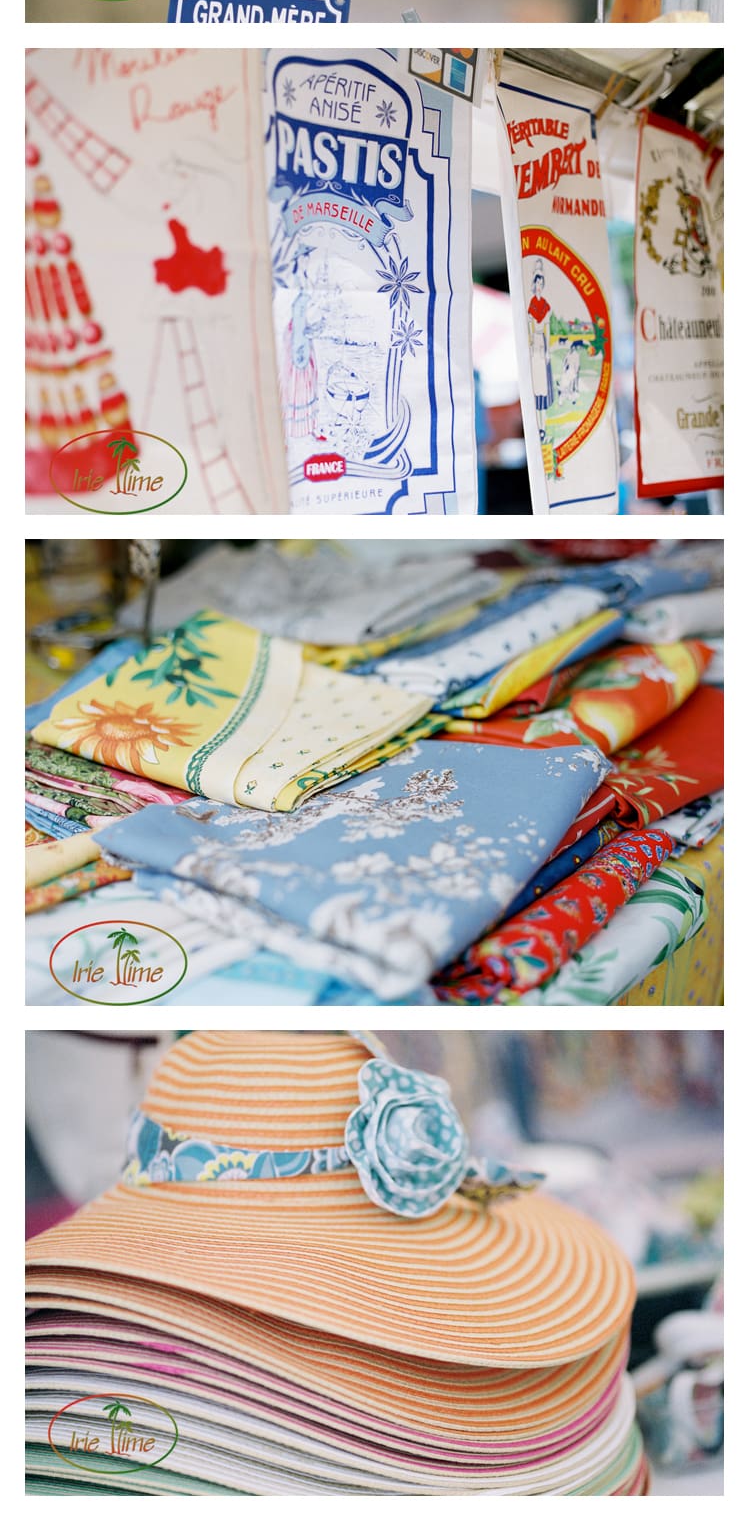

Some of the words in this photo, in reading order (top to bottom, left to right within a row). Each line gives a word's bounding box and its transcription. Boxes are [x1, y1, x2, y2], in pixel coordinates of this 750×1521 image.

[300, 72, 377, 102] APÉRITIF
[309, 96, 362, 124] ANISÉ
[277, 119, 403, 190] PASTIS
[292, 205, 305, 225] DE
[306, 202, 375, 234] MARSEILLE
[548, 243, 571, 267] LAIT
[570, 265, 595, 297] CRU
[677, 405, 720, 430] Grande
[306, 460, 344, 476] FRANCE
[317, 488, 384, 505] SUPÉRIEURE
